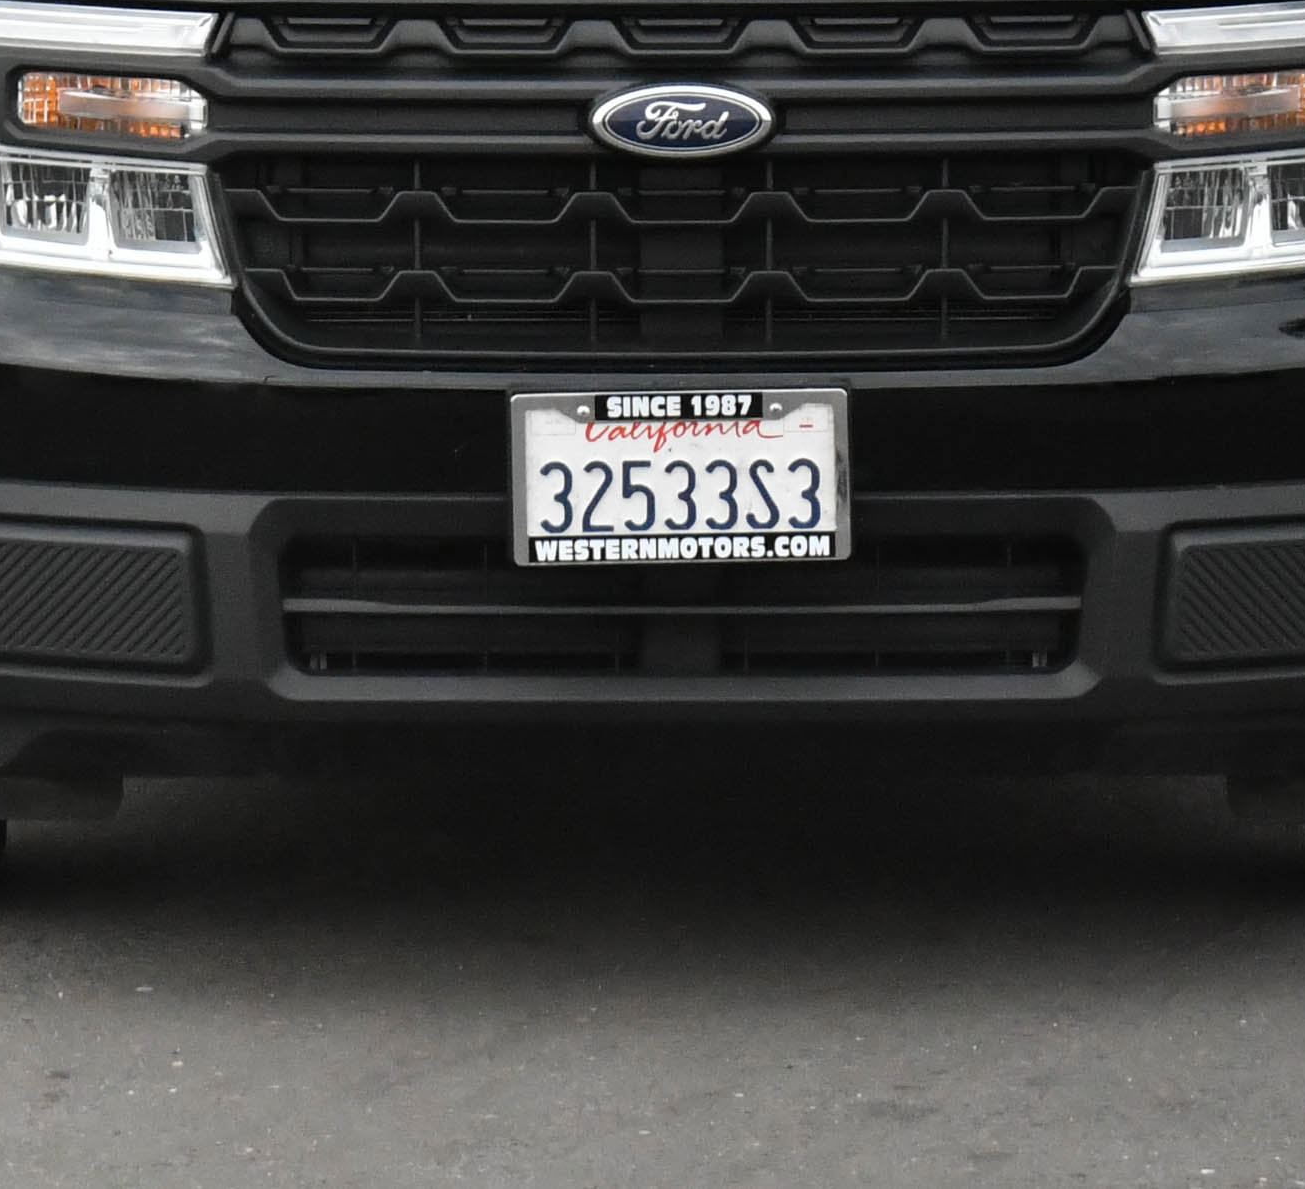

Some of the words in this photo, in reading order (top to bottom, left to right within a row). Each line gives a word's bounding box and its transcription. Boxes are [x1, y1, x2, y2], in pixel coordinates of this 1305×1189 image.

[635, 100, 730, 141] Ford
[606, 394, 682, 418] SINCE
[691, 393, 753, 416] 1987
[584, 419, 784, 453] California
[539, 457, 822, 534] 32533S3
[534, 535, 832, 562] WESTERNMOTORS.COM
